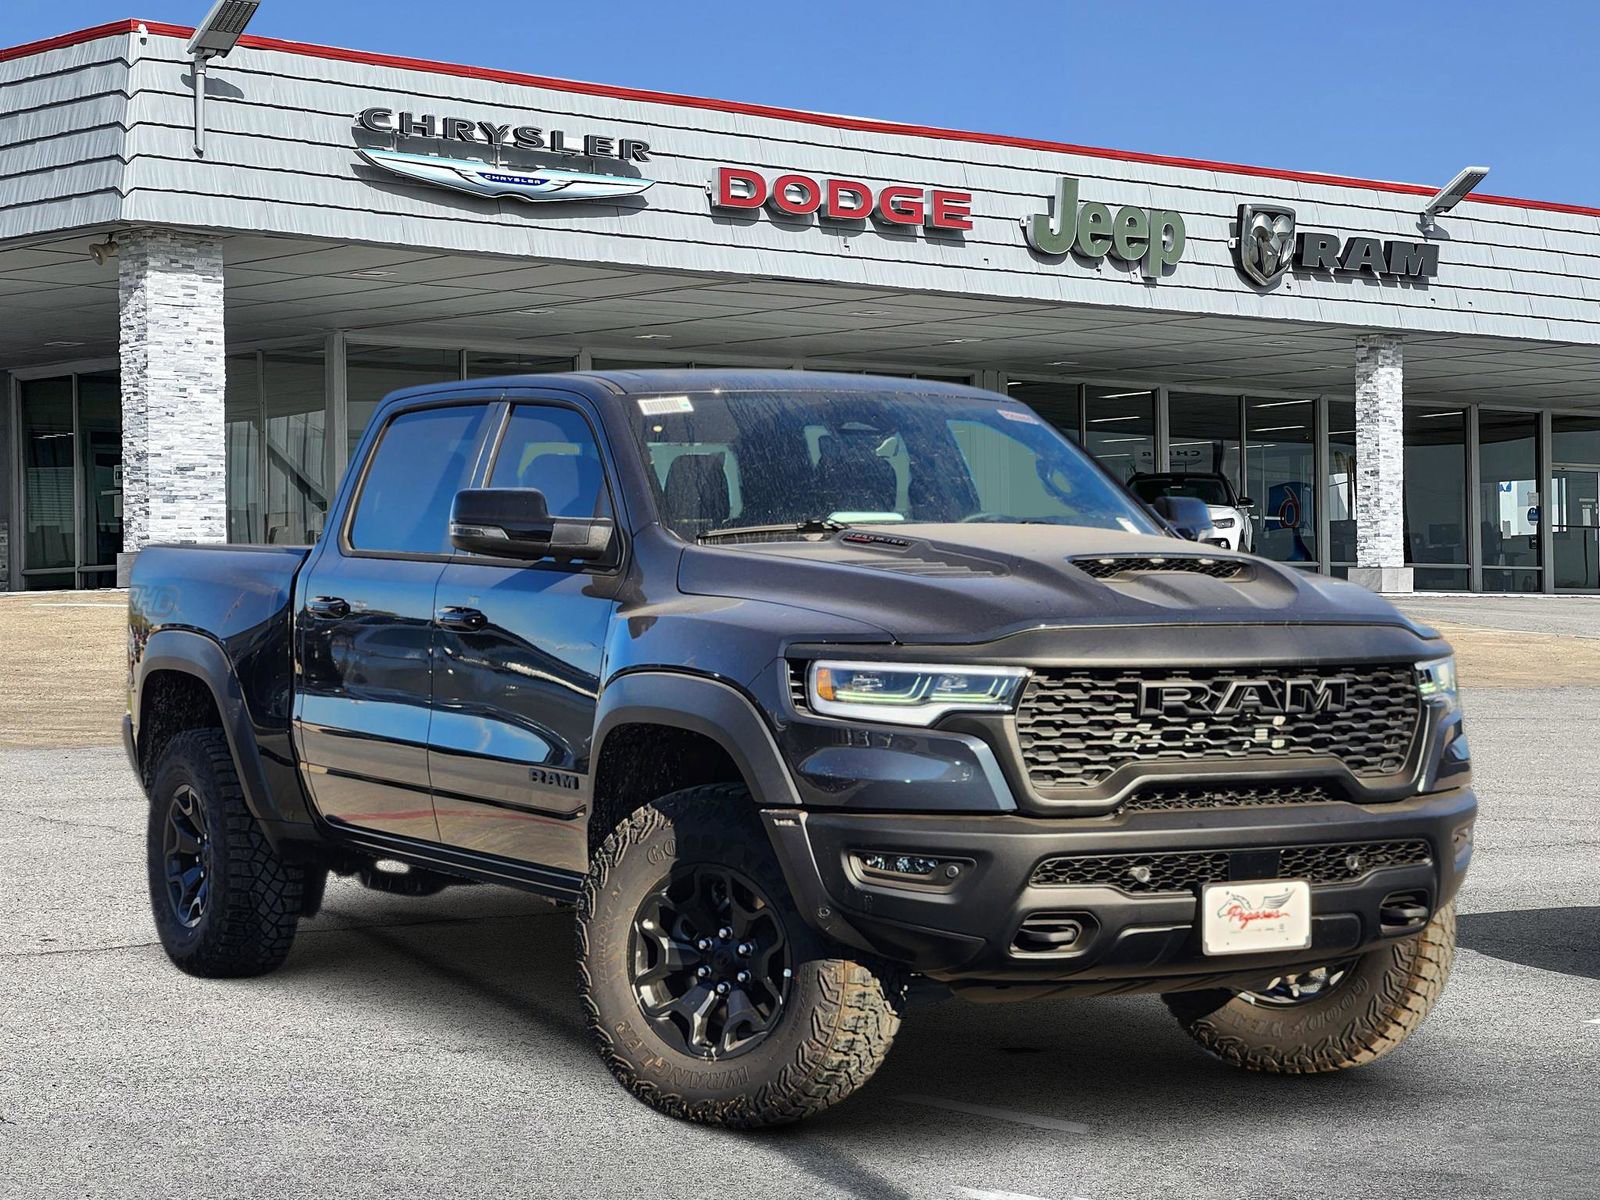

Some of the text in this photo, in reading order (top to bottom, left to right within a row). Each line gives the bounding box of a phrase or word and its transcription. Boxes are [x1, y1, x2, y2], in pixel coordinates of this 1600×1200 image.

[358, 107, 650, 162] CHRYSLER
[484, 174, 541, 185] CHRYSLER
[712, 166, 973, 230] DODGE
[1026, 176, 1186, 279] Jeep
[1296, 232, 1439, 277] RAM
[1139, 678, 1348, 716] RAM
[528, 767, 580, 790] RAM
[614, 1020, 751, 1090] WRANGLER
